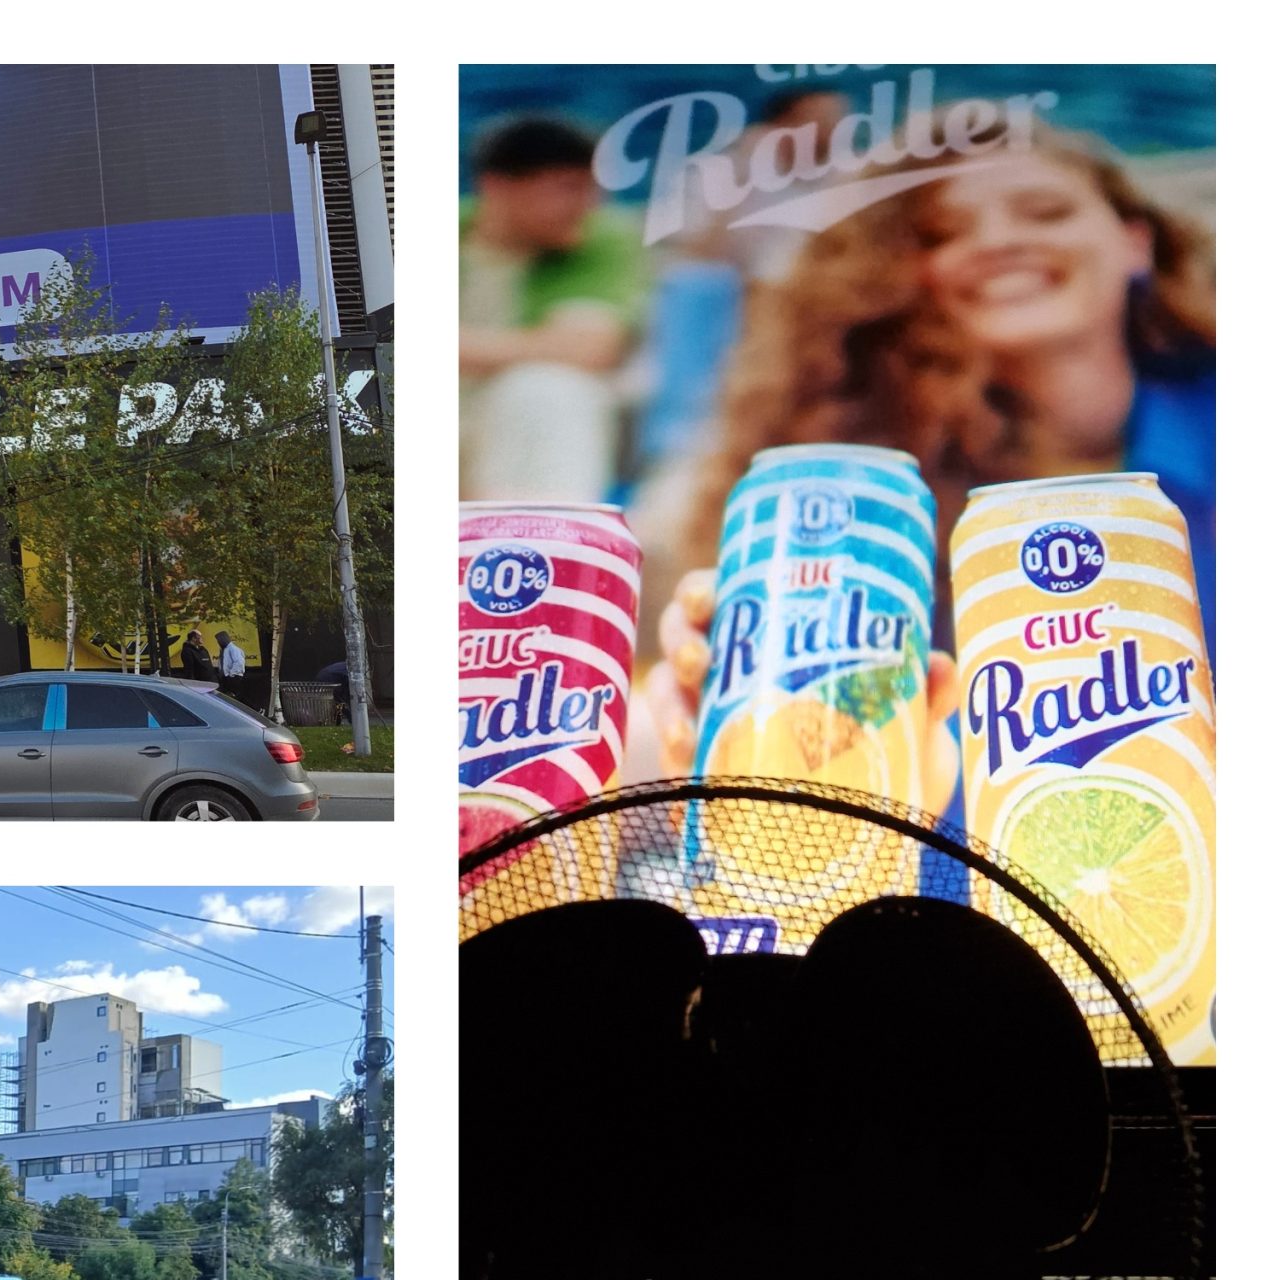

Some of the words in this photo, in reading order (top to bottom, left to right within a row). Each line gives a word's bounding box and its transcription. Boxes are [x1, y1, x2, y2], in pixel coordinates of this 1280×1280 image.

[592, 66, 1059, 248] Radler
[115, 370, 375, 448] PAK
[1033, 523, 1089, 543] ALCOOL
[1025, 537, 1103, 577] 0,0%
[471, 558, 547, 597] 0,0%
[1051, 580, 1085, 591] VOL.
[459, 664, 613, 749] adler
[970, 640, 1194, 778] Radler
[1159, 995, 1194, 1029] IME
